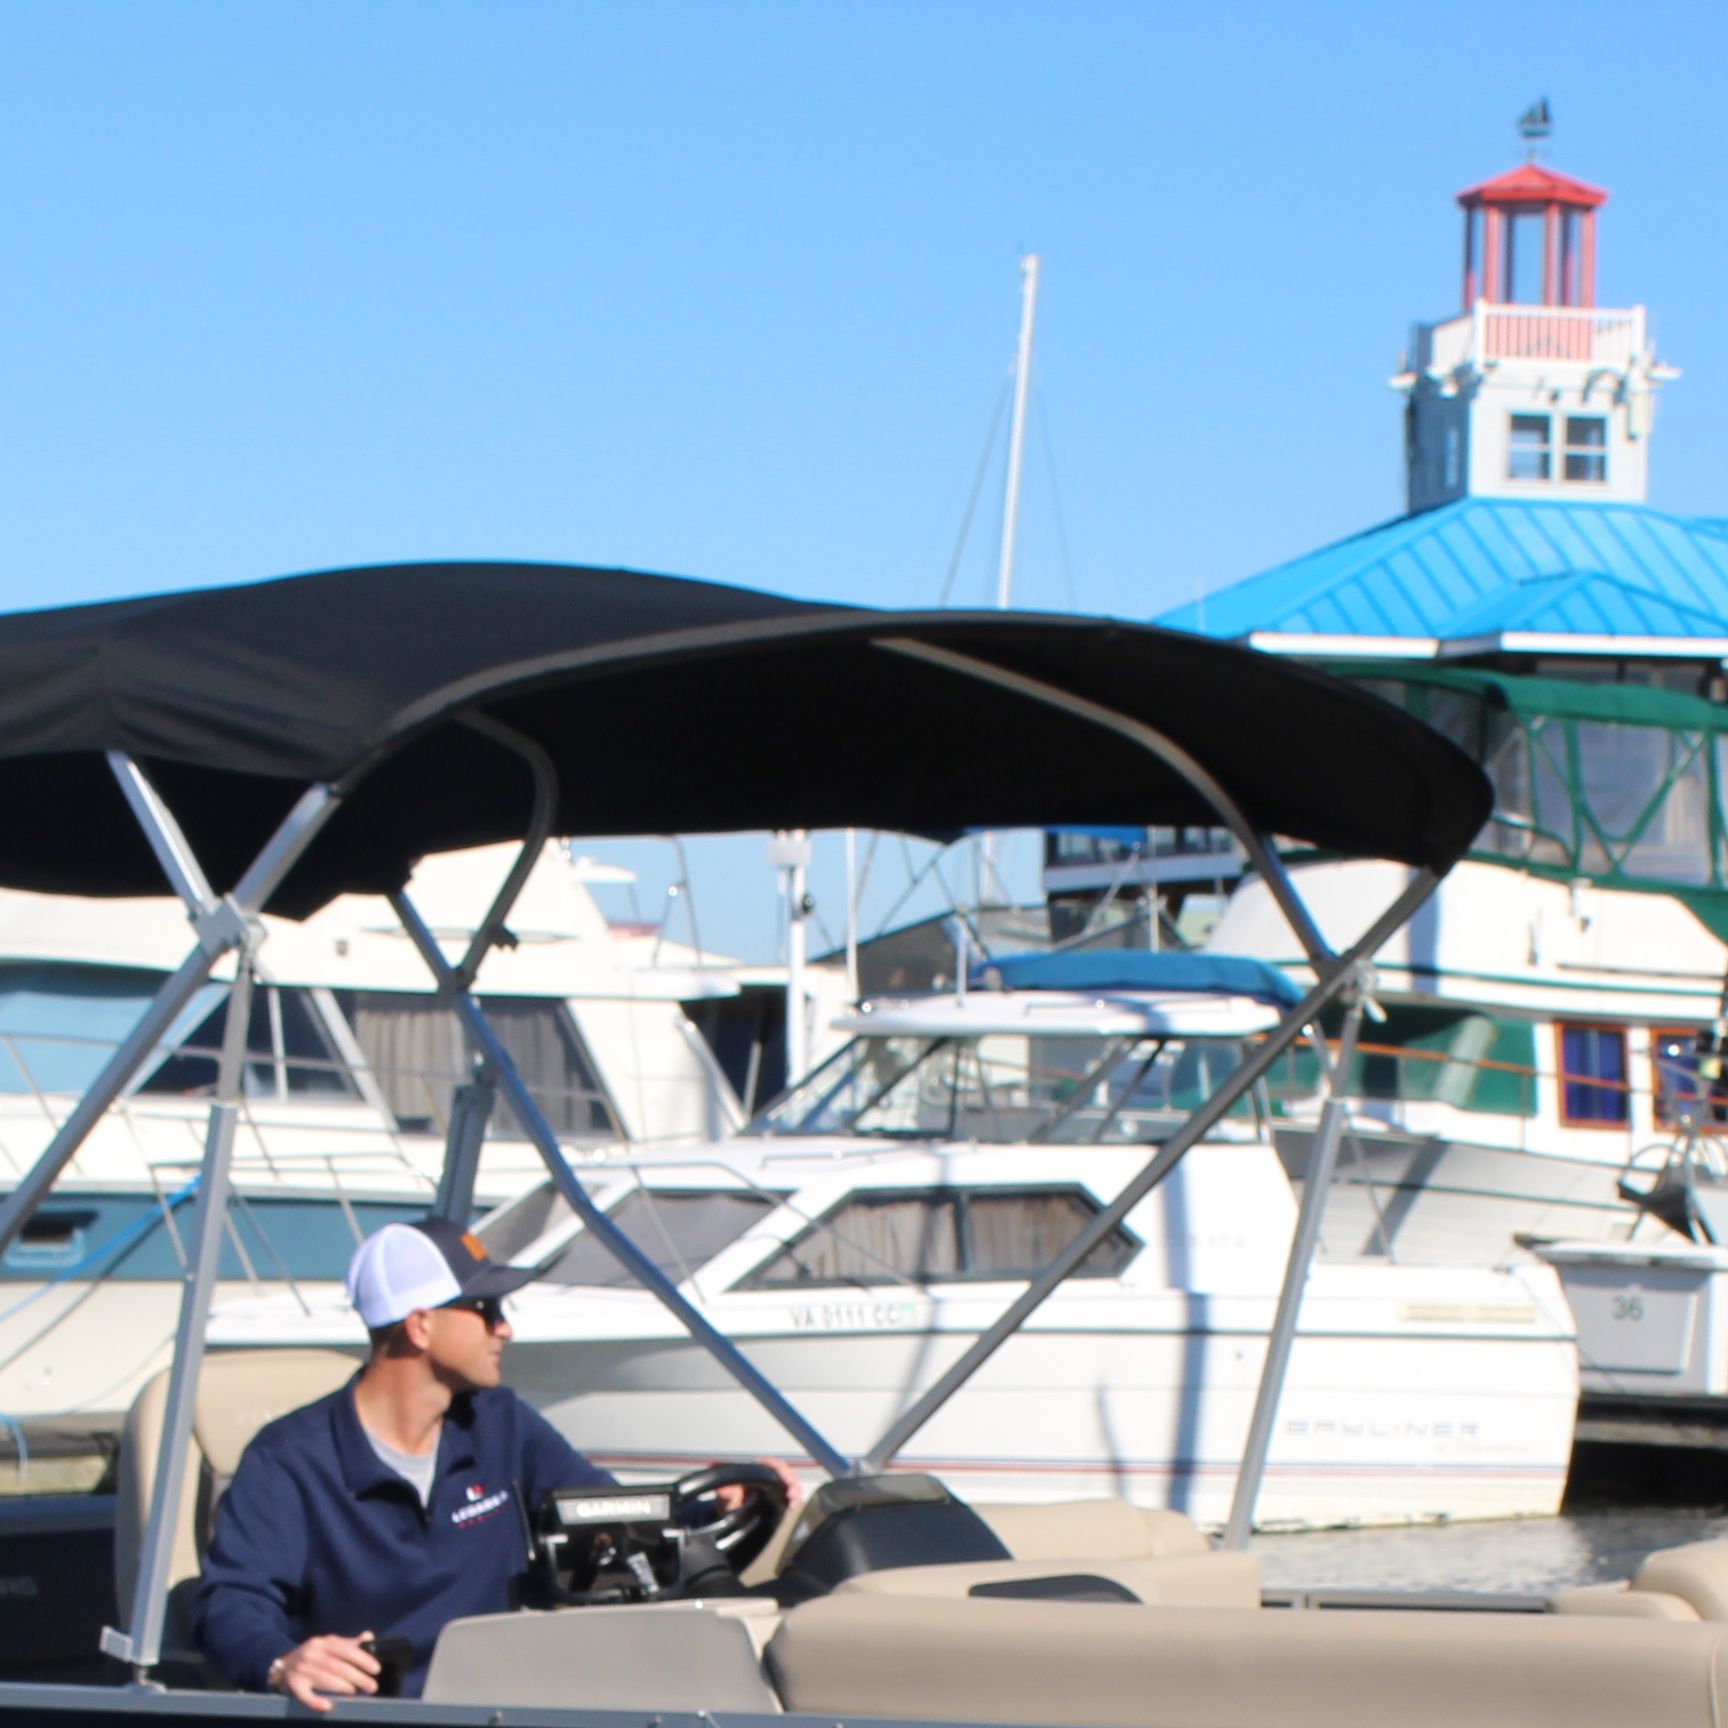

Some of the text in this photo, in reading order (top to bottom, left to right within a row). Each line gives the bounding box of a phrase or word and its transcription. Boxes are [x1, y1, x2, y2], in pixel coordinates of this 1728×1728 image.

[1612, 1294, 1645, 1321] 36
[1285, 1418, 1482, 1438] BAYLINER
[576, 1500, 652, 1518] GARMIN
